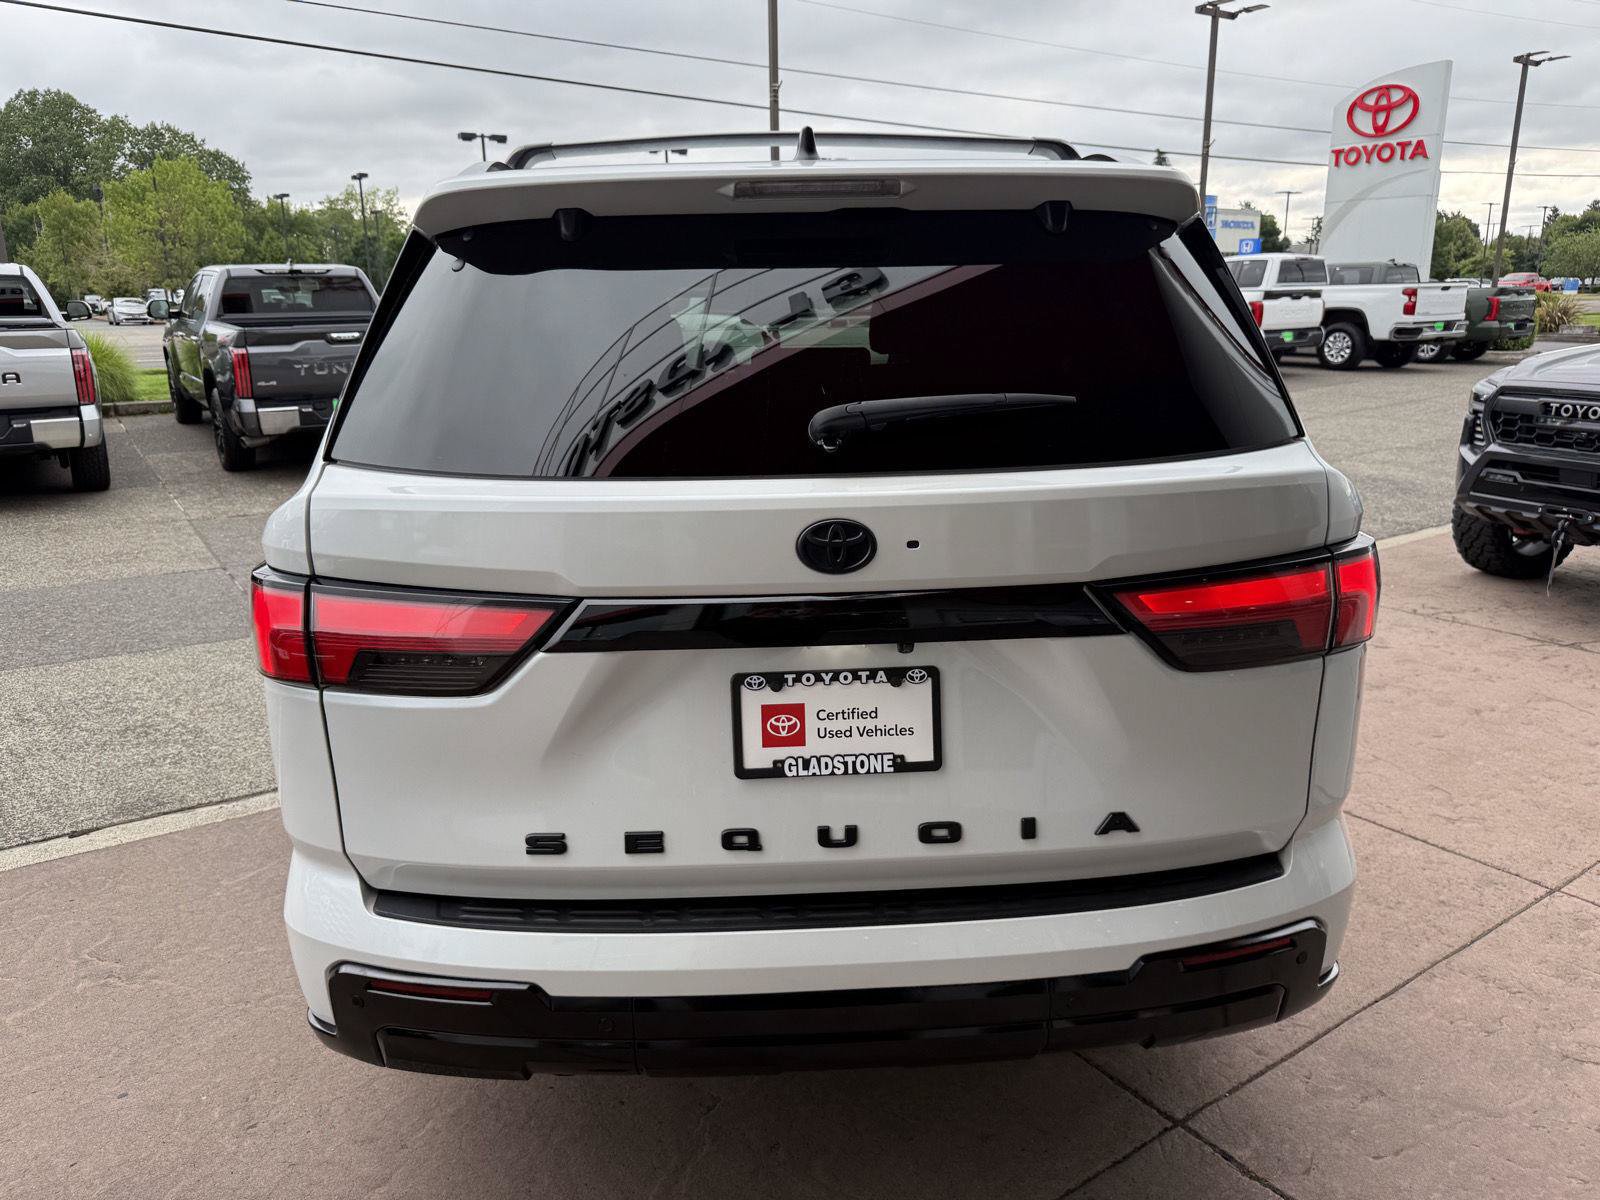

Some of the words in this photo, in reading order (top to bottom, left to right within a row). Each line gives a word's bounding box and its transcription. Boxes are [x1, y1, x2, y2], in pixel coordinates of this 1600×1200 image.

[1331, 139, 1428, 167] TOYOTA
[294, 360, 354, 376] TUN
[1550, 403, 1600, 420] TOYO
[784, 670, 888, 687] TOYOTA
[816, 707, 878, 722] Certified
[816, 725, 853, 739] Used
[856, 724, 915, 738] Vehicles
[783, 754, 895, 777] GLADSTONE
[525, 811, 1140, 855] SEQUOIA
